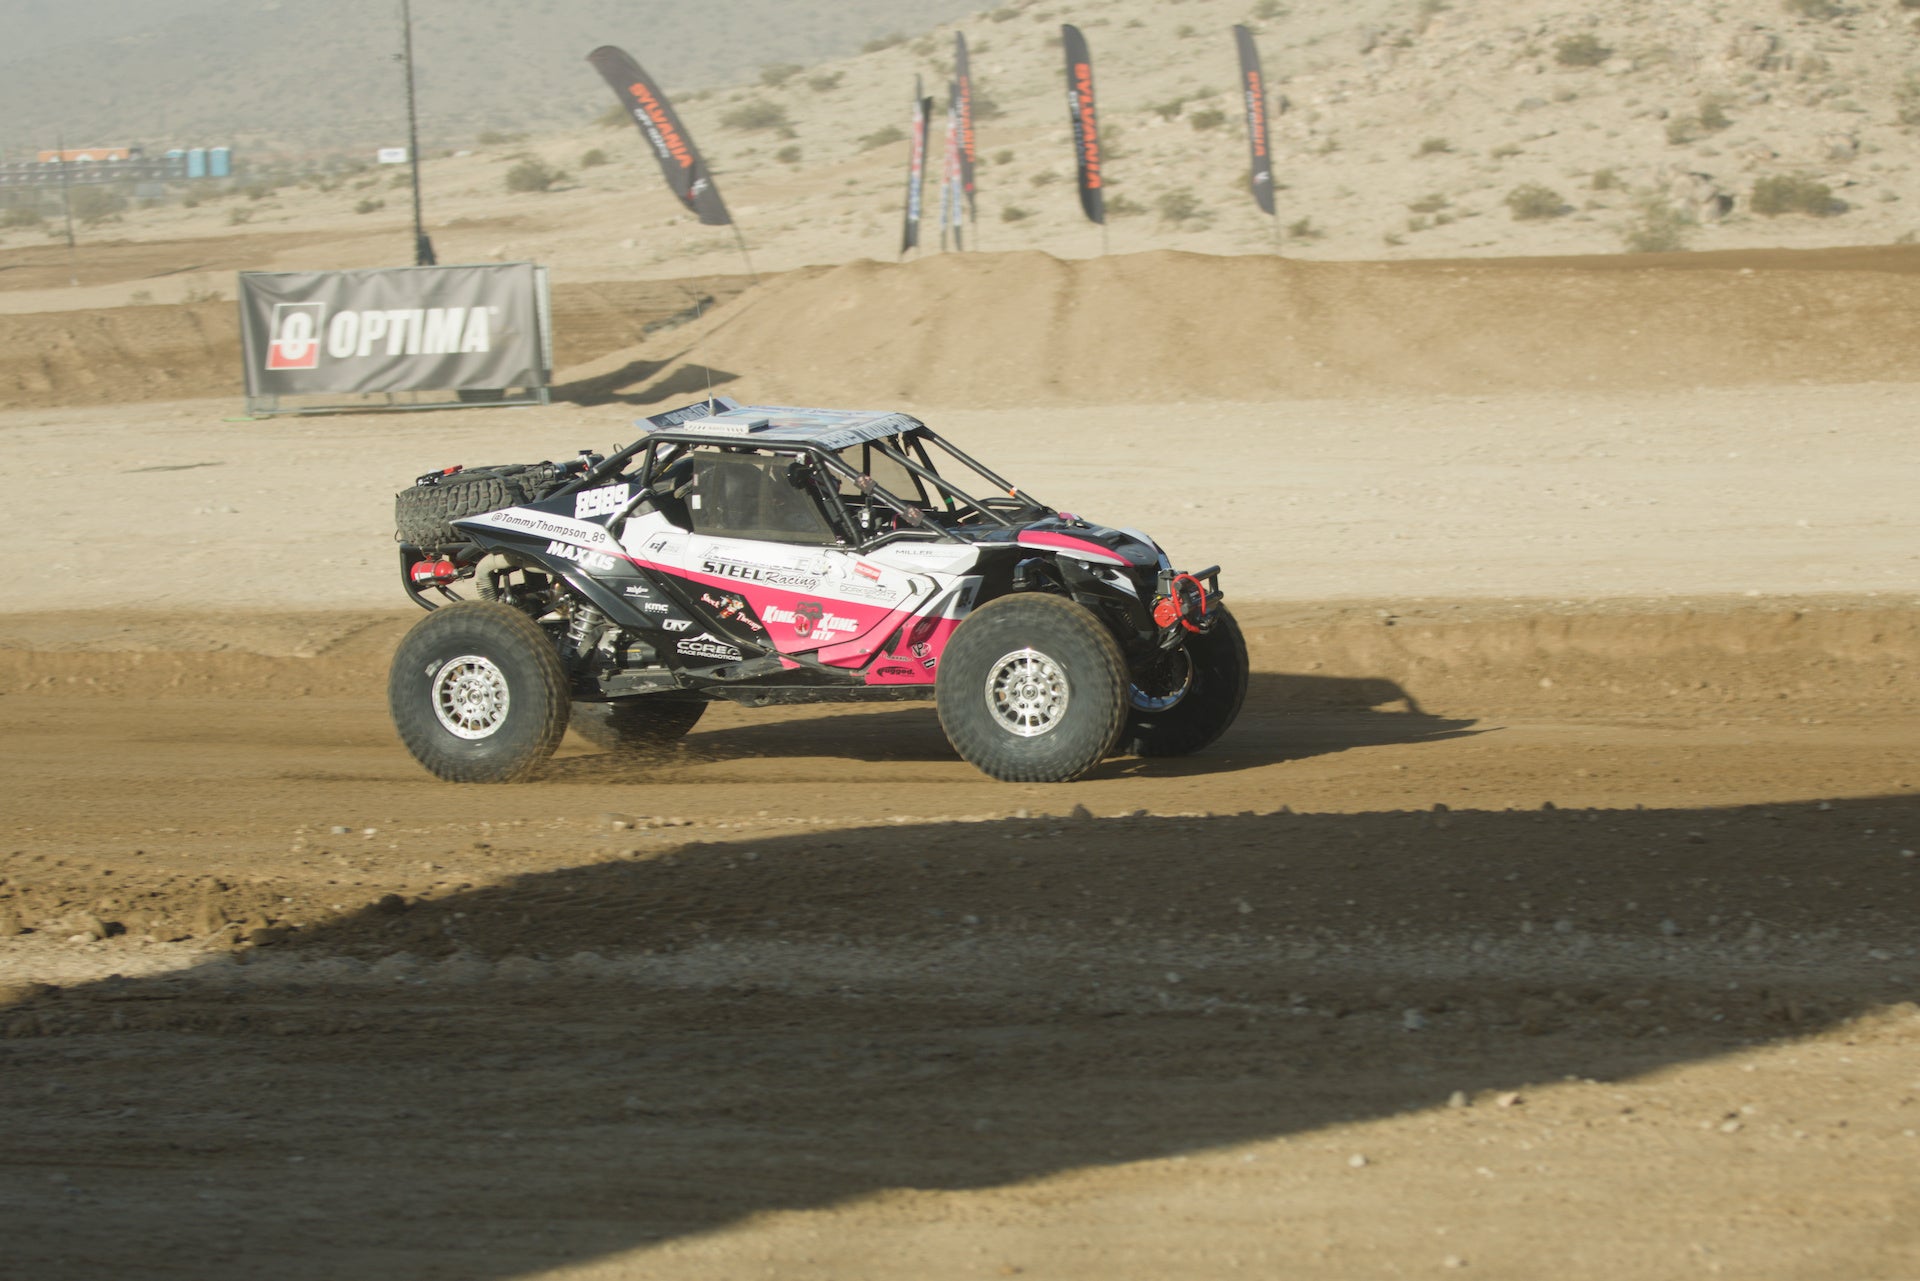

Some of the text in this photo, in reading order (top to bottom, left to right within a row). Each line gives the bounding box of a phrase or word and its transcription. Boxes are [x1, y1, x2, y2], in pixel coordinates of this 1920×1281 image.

[628, 82, 694, 168] SYLVANIA
[1074, 63, 1102, 188] SYLVANIA
[327, 306, 490, 358] OPTIMA
[575, 483, 630, 519] 8989
[491, 512, 606, 544] @TommyThompson_89
[546, 541, 616, 571] MAXXIS
[763, 571, 819, 591] Racing
[677, 641, 727, 655] CORE
[677, 649, 743, 662] RACE PROMOTIONS
